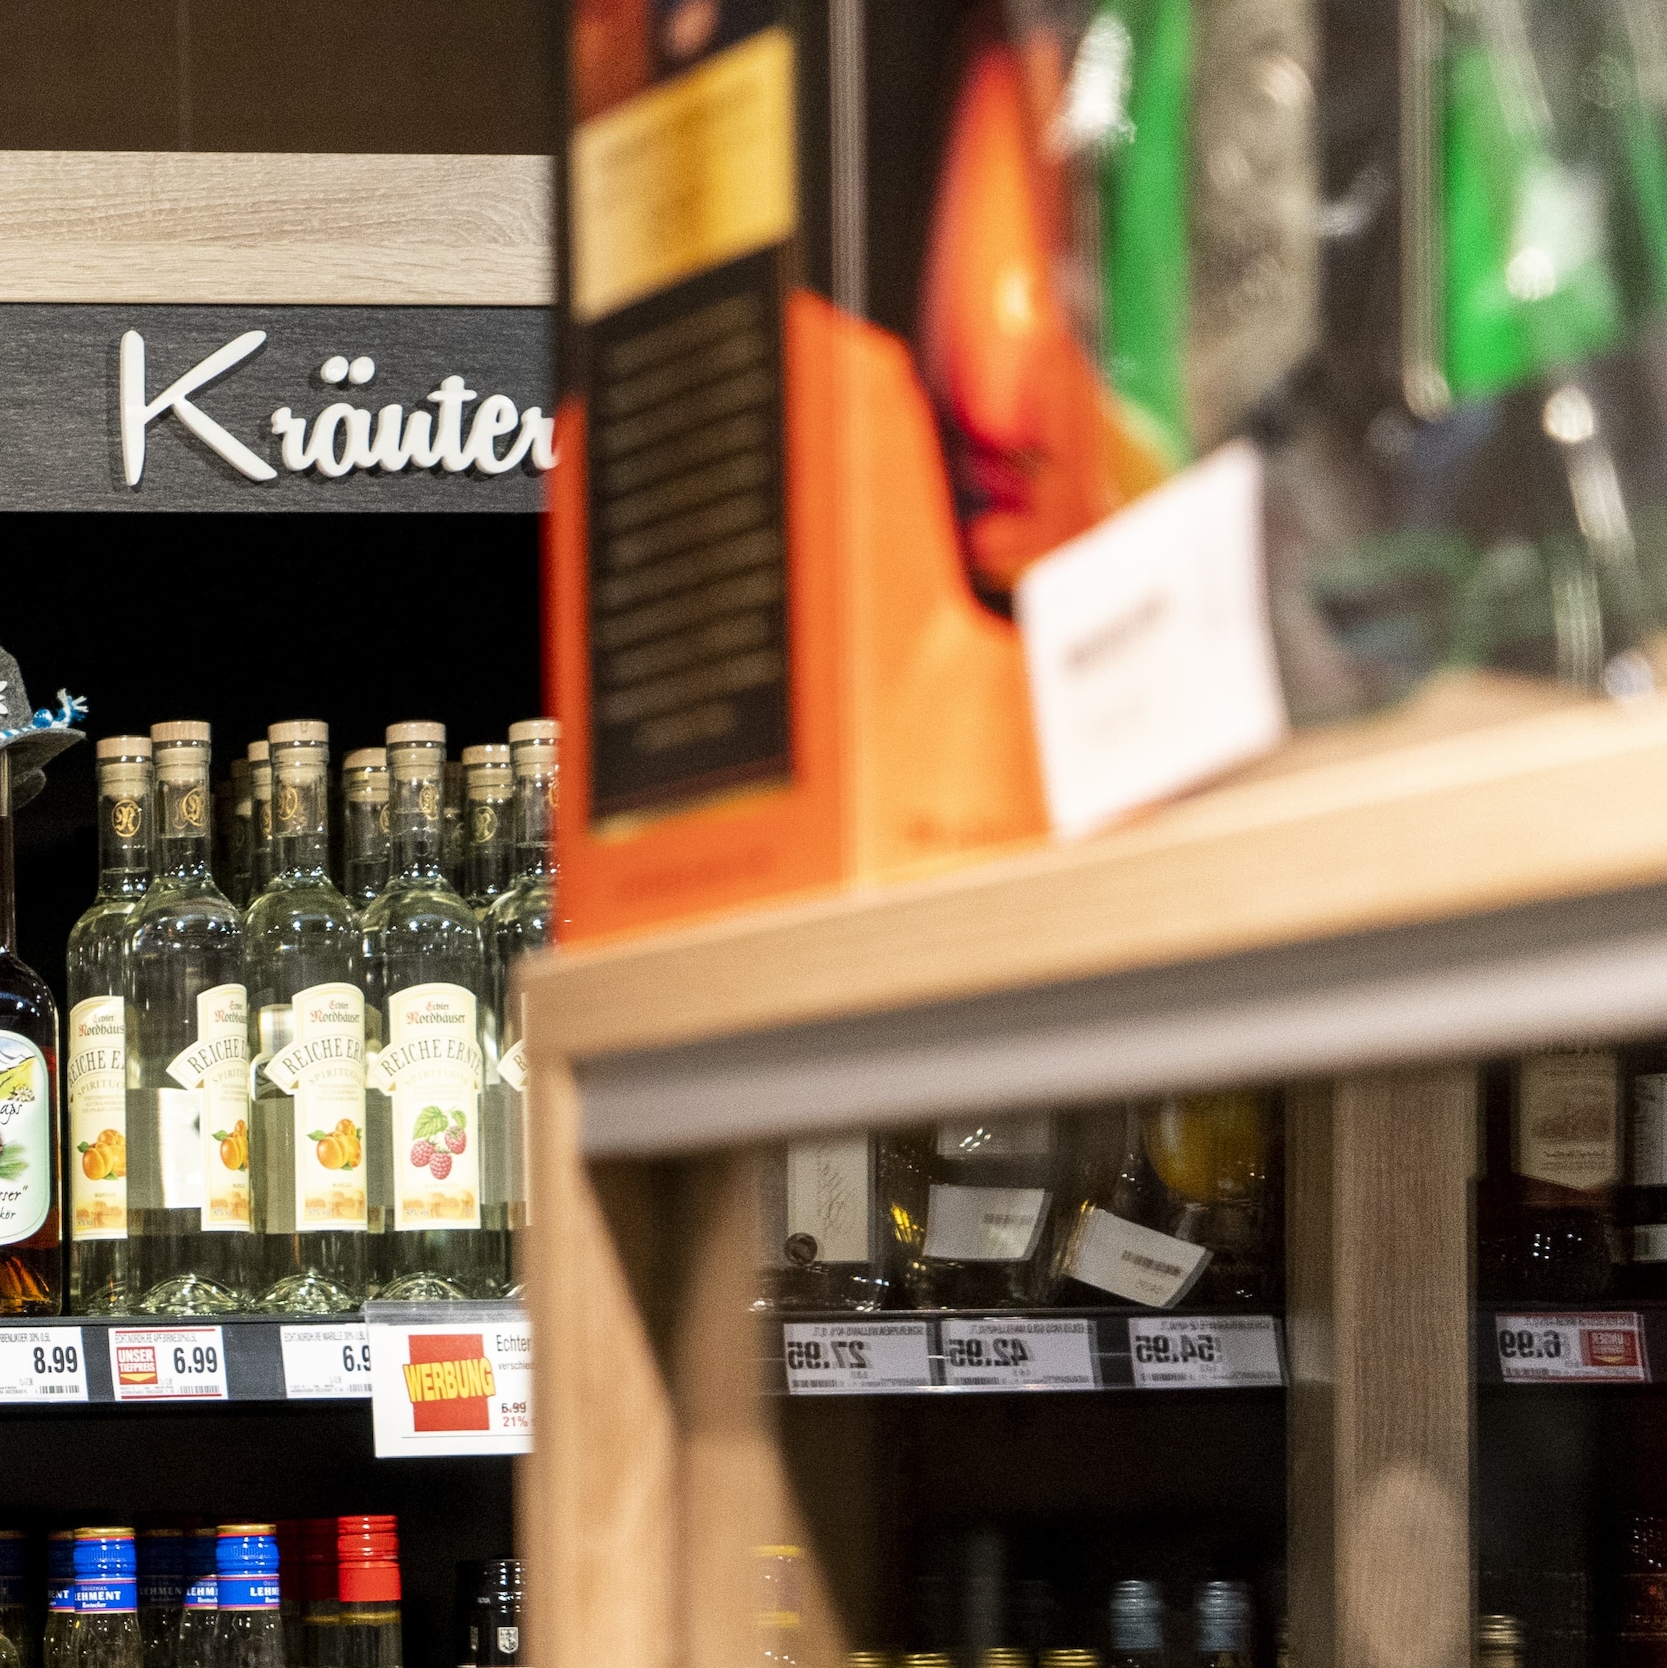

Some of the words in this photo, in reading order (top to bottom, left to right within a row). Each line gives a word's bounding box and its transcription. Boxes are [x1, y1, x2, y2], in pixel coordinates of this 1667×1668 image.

[120, 330, 560, 486] Kräuter
[381, 1038, 441, 1077] REICHE
[119, 1350, 155, 1363] UNSER
[120, 1361, 155, 1371] TIEFPREIS
[174, 1345, 217, 1374] 6.99
[403, 1357, 496, 1403] WERBUNG
